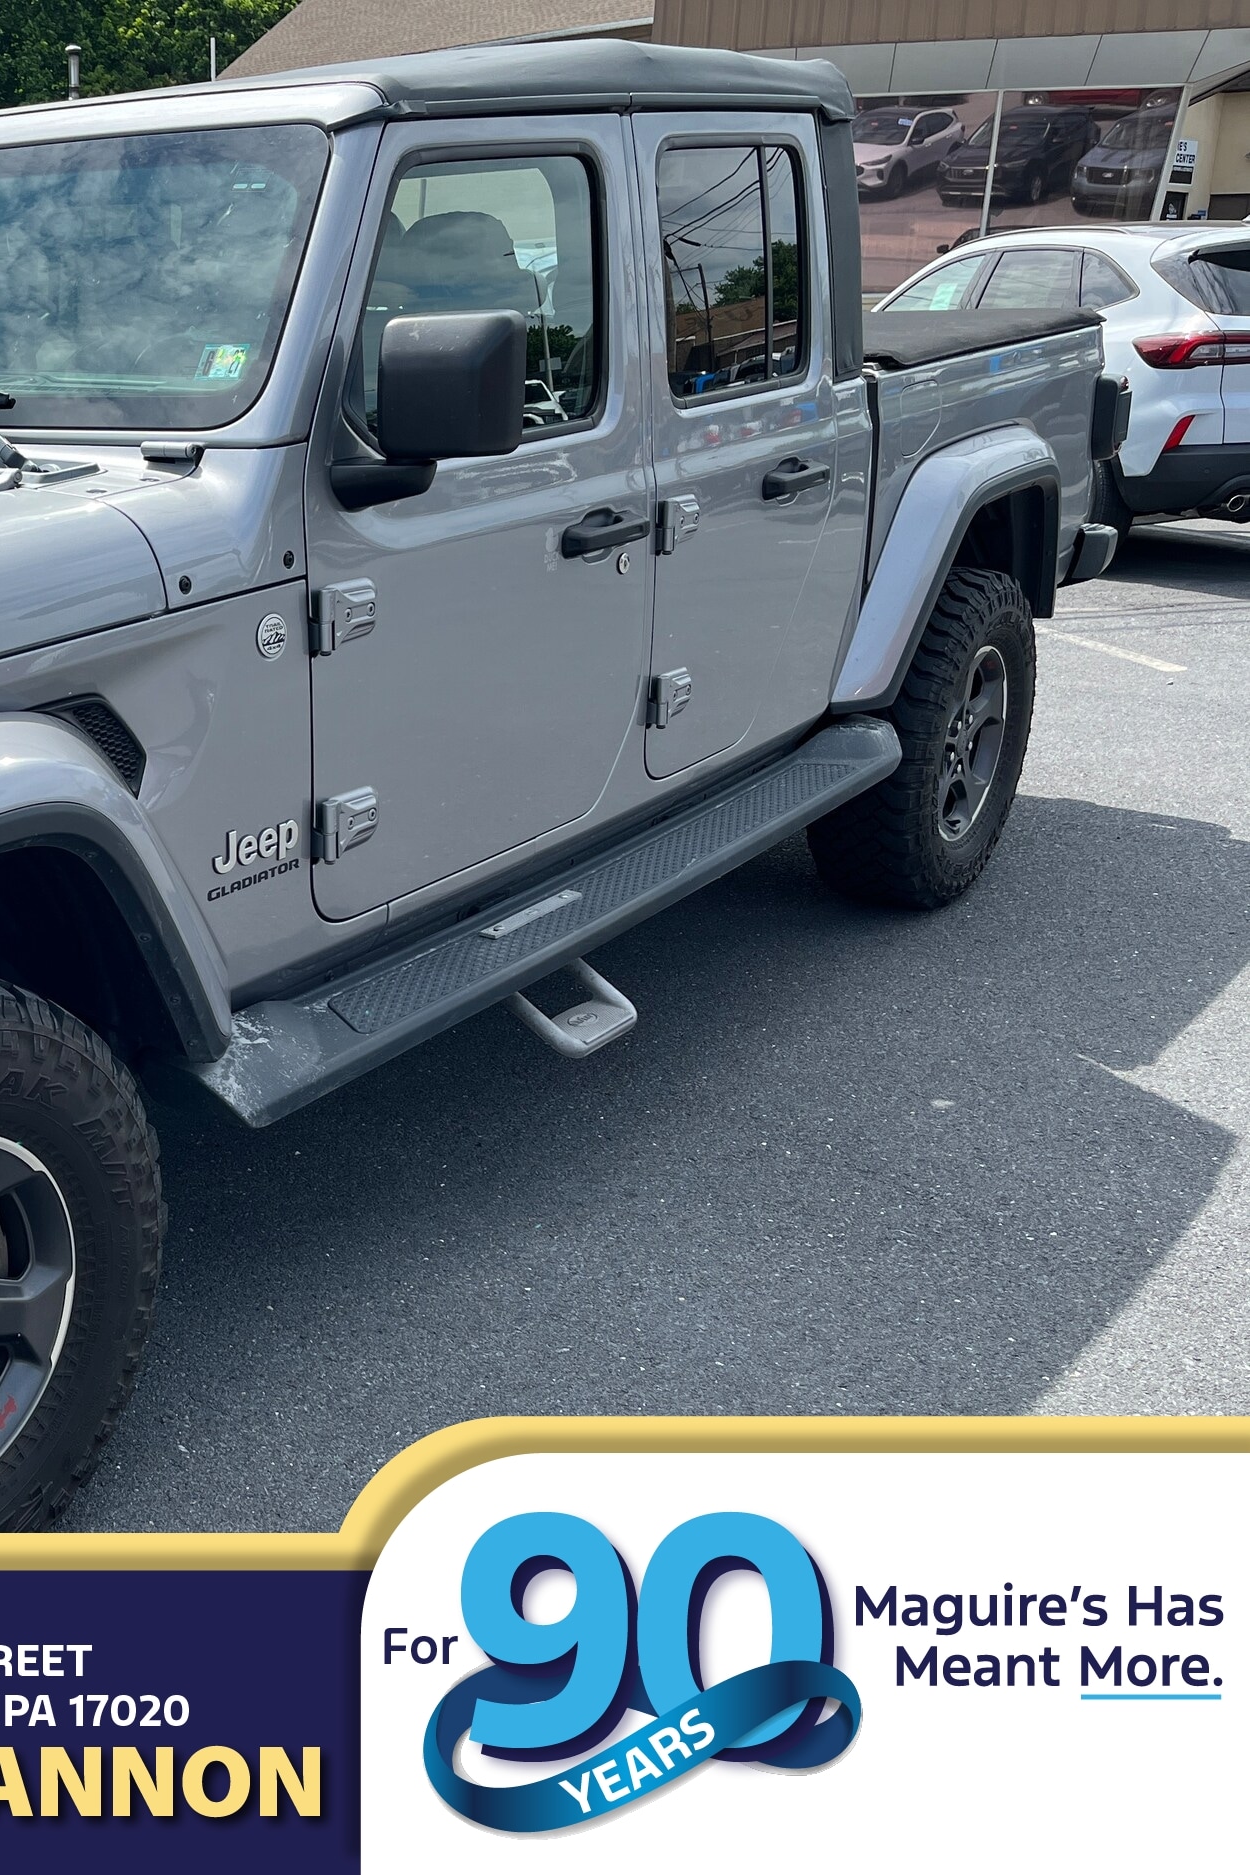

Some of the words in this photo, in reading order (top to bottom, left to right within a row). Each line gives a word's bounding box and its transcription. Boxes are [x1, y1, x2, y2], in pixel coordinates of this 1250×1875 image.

[1175, 153, 1196, 164] CENTER
[212, 819, 299, 875] Jeep
[207, 858, 300, 902] GLADIATOR
